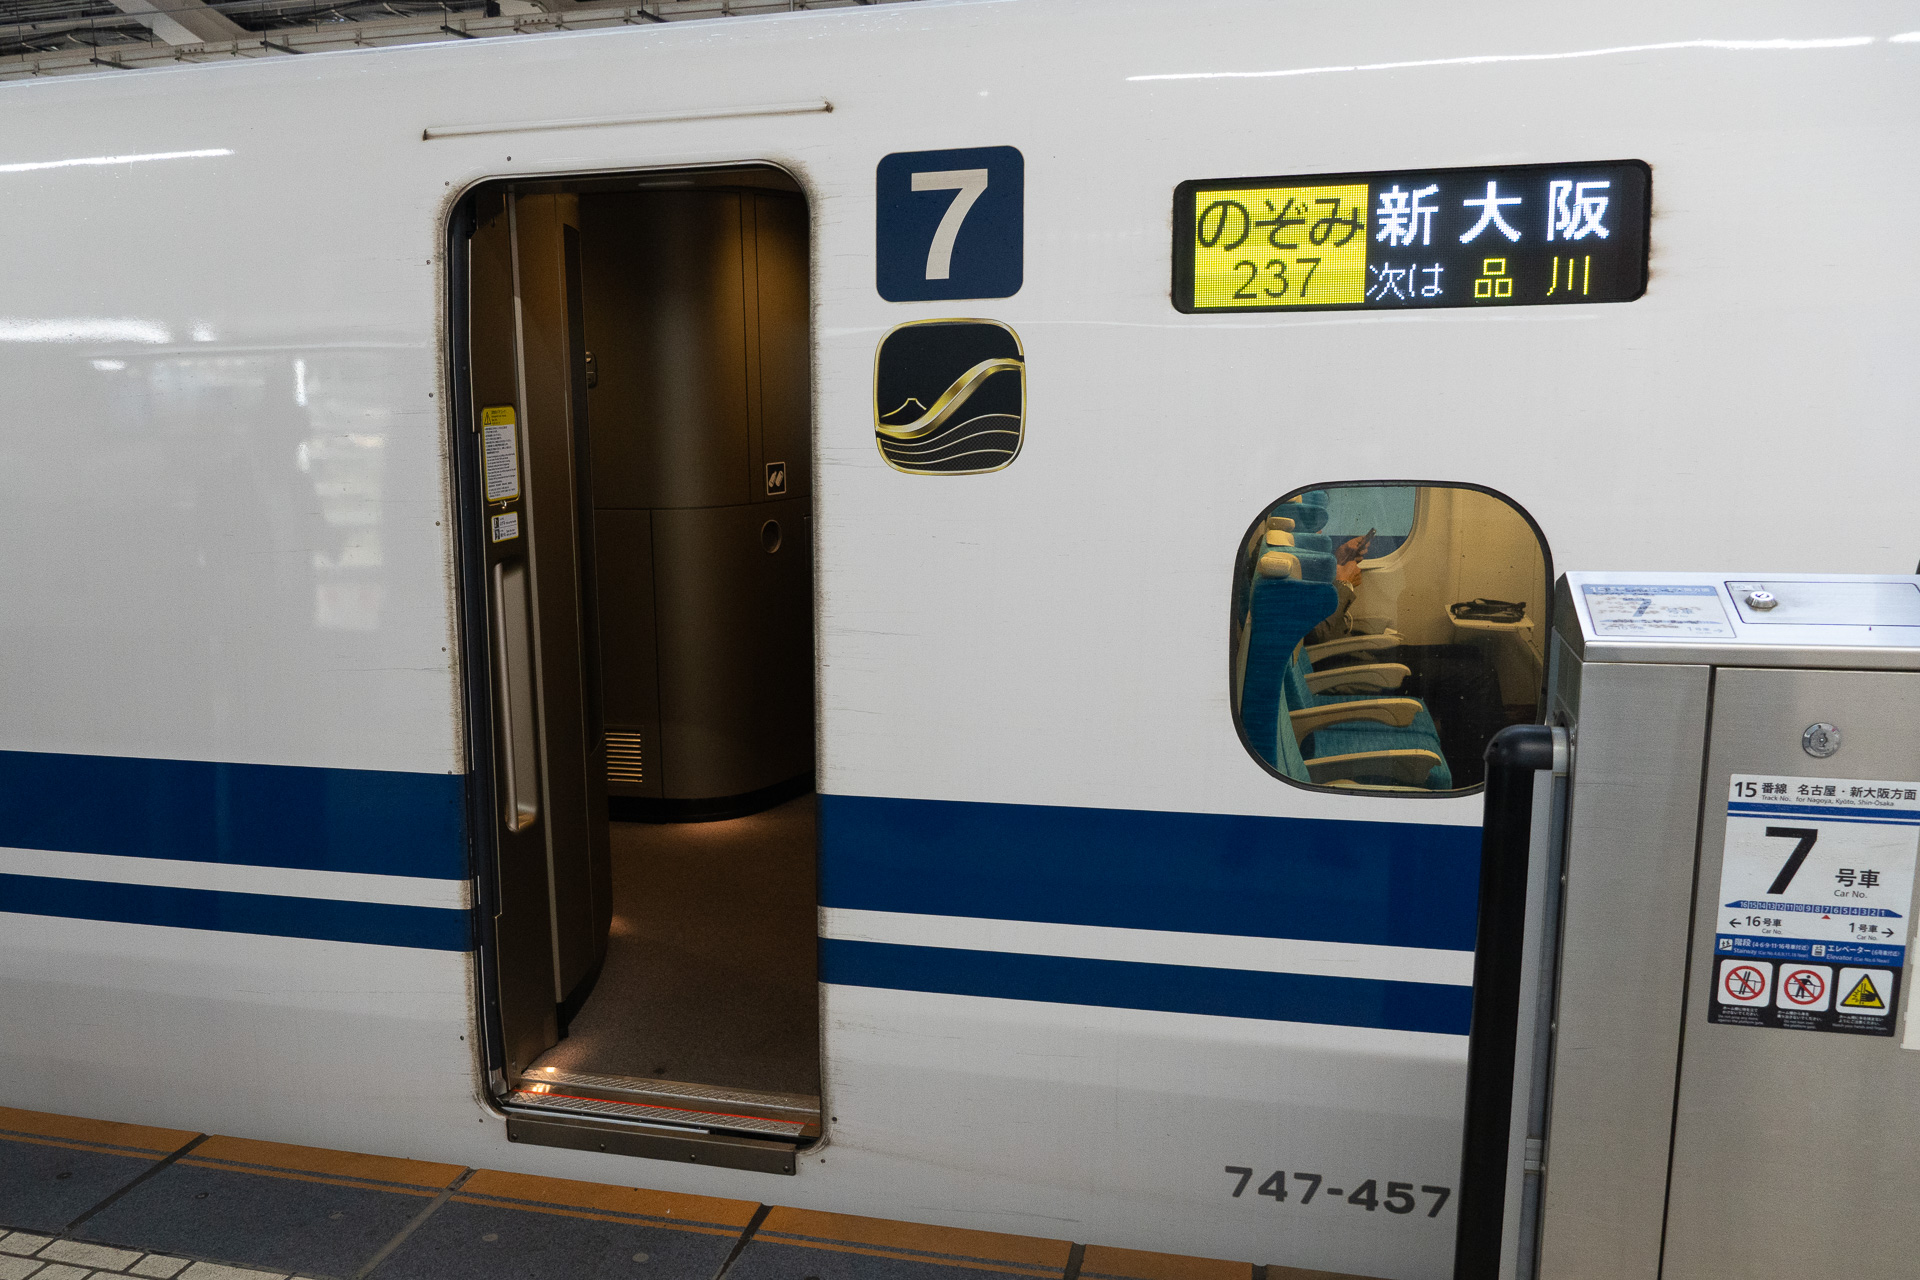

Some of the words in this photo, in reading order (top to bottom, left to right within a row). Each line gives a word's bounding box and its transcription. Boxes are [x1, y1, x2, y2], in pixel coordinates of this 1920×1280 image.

[911, 168, 988, 280] 7
[1197, 198, 1365, 251] のぞみ
[1376, 180, 1611, 247] 新大阪
[1232, 258, 1321, 299] 237
[1366, 262, 1444, 300] 次は
[1474, 256, 1590, 298] 品川
[1622, 597, 1652, 617] 7
[1765, 826, 1818, 894] 7
[1834, 868, 1880, 888] 号車
[1852, 891, 1867, 899] No.
[1826, 953, 1852, 961] Elevator
[1225, 1165, 1451, 1218] 747-457
